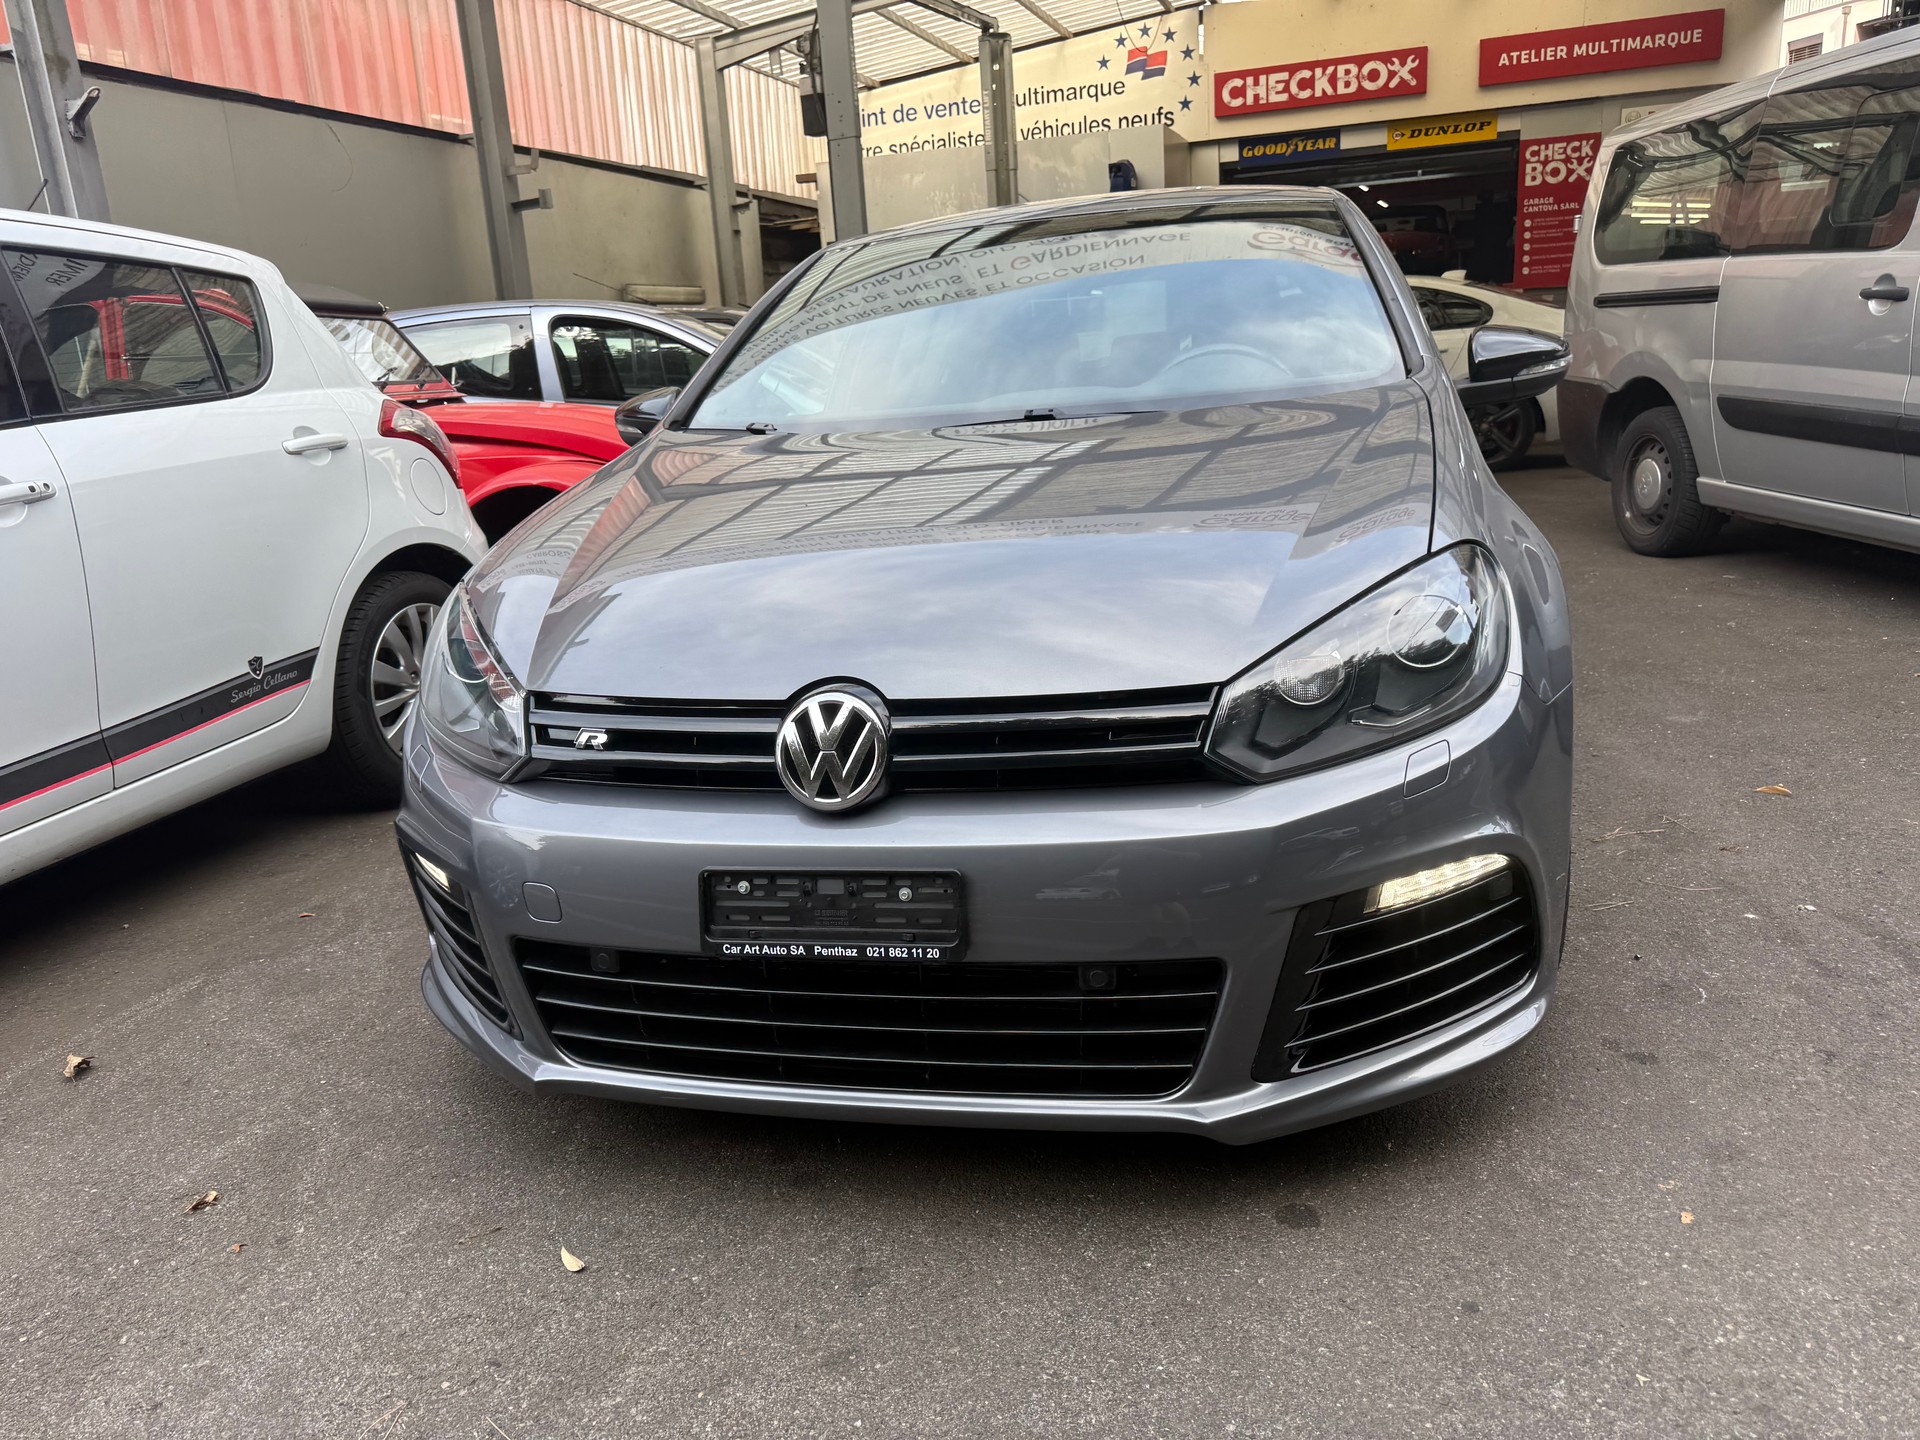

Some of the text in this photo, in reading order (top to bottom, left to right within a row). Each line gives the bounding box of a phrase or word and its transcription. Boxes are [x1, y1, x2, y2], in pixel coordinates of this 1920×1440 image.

[1497, 28, 1703, 67] ATELIER MULTIMARQUE
[1221, 54, 1420, 108] CHECKBOX
[861, 80, 1125, 127] int de vente ultimarque
[1020, 115, 1111, 140] véhicules
[1118, 106, 1175, 128] neufs
[1408, 121, 1492, 139] DUNLOP
[1242, 136, 1338, 158] GOODYEAR
[1525, 139, 1595, 162] CHECK
[1524, 157, 1594, 187] BOX
[1523, 197, 1554, 206] GARAGE
[1523, 204, 1558, 213] CANTOVA
[230, 670, 298, 704] Sergio Cellano
[574, 727, 609, 750] R
[722, 943, 940, 959] Car Art Auto SA Penthaz 021 862 11 20
